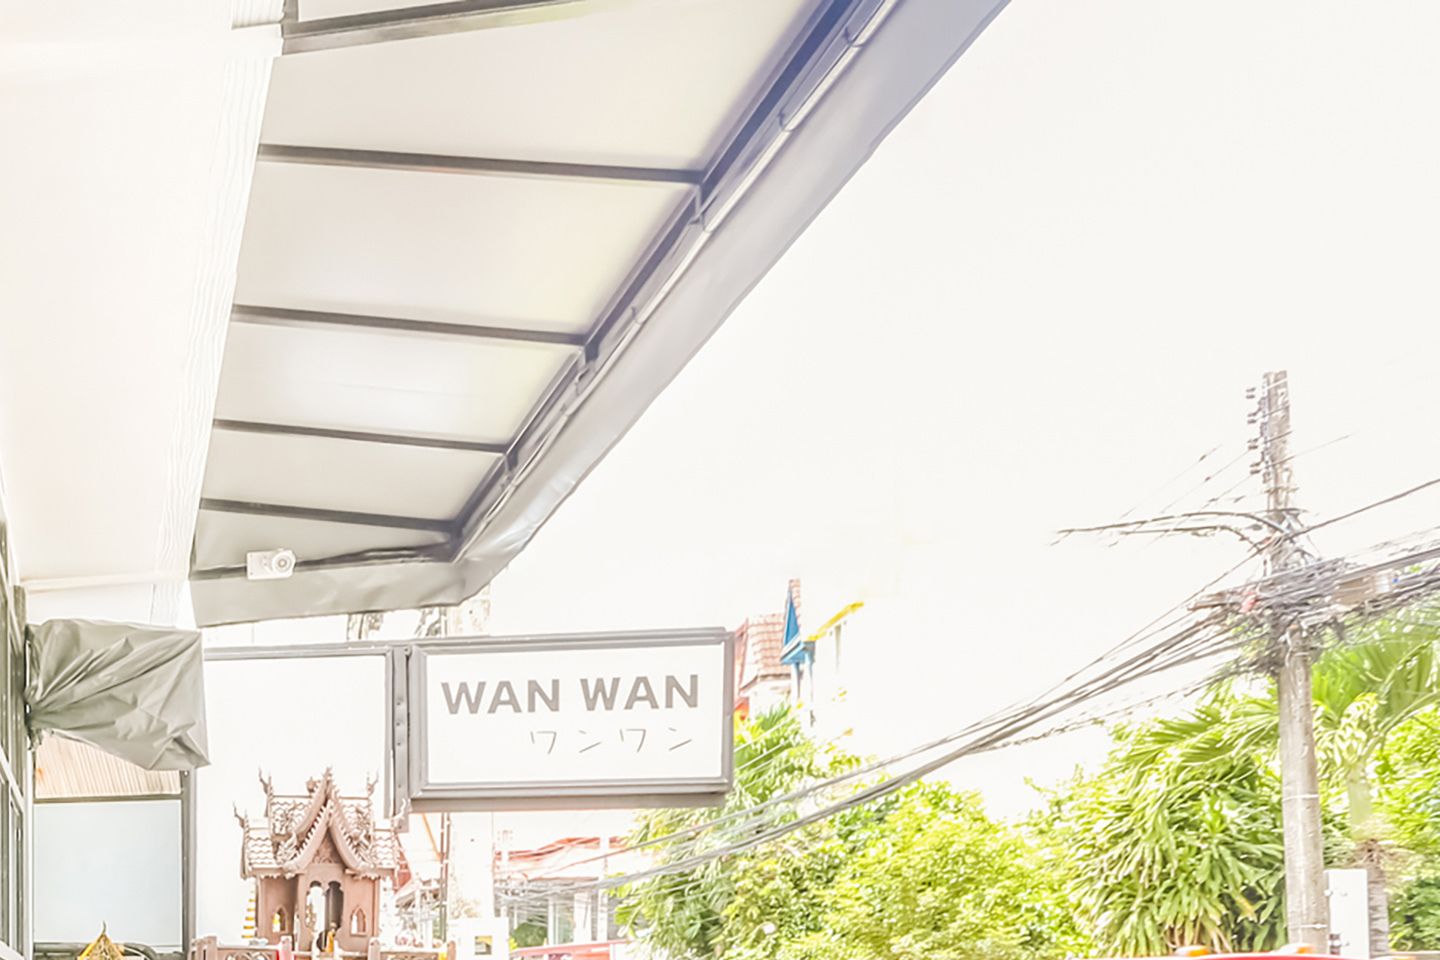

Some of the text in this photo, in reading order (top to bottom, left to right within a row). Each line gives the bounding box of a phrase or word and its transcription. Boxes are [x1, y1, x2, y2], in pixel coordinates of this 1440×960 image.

[441, 674, 699, 715] WAN WAN
[530, 727, 693, 755] ワンワン
